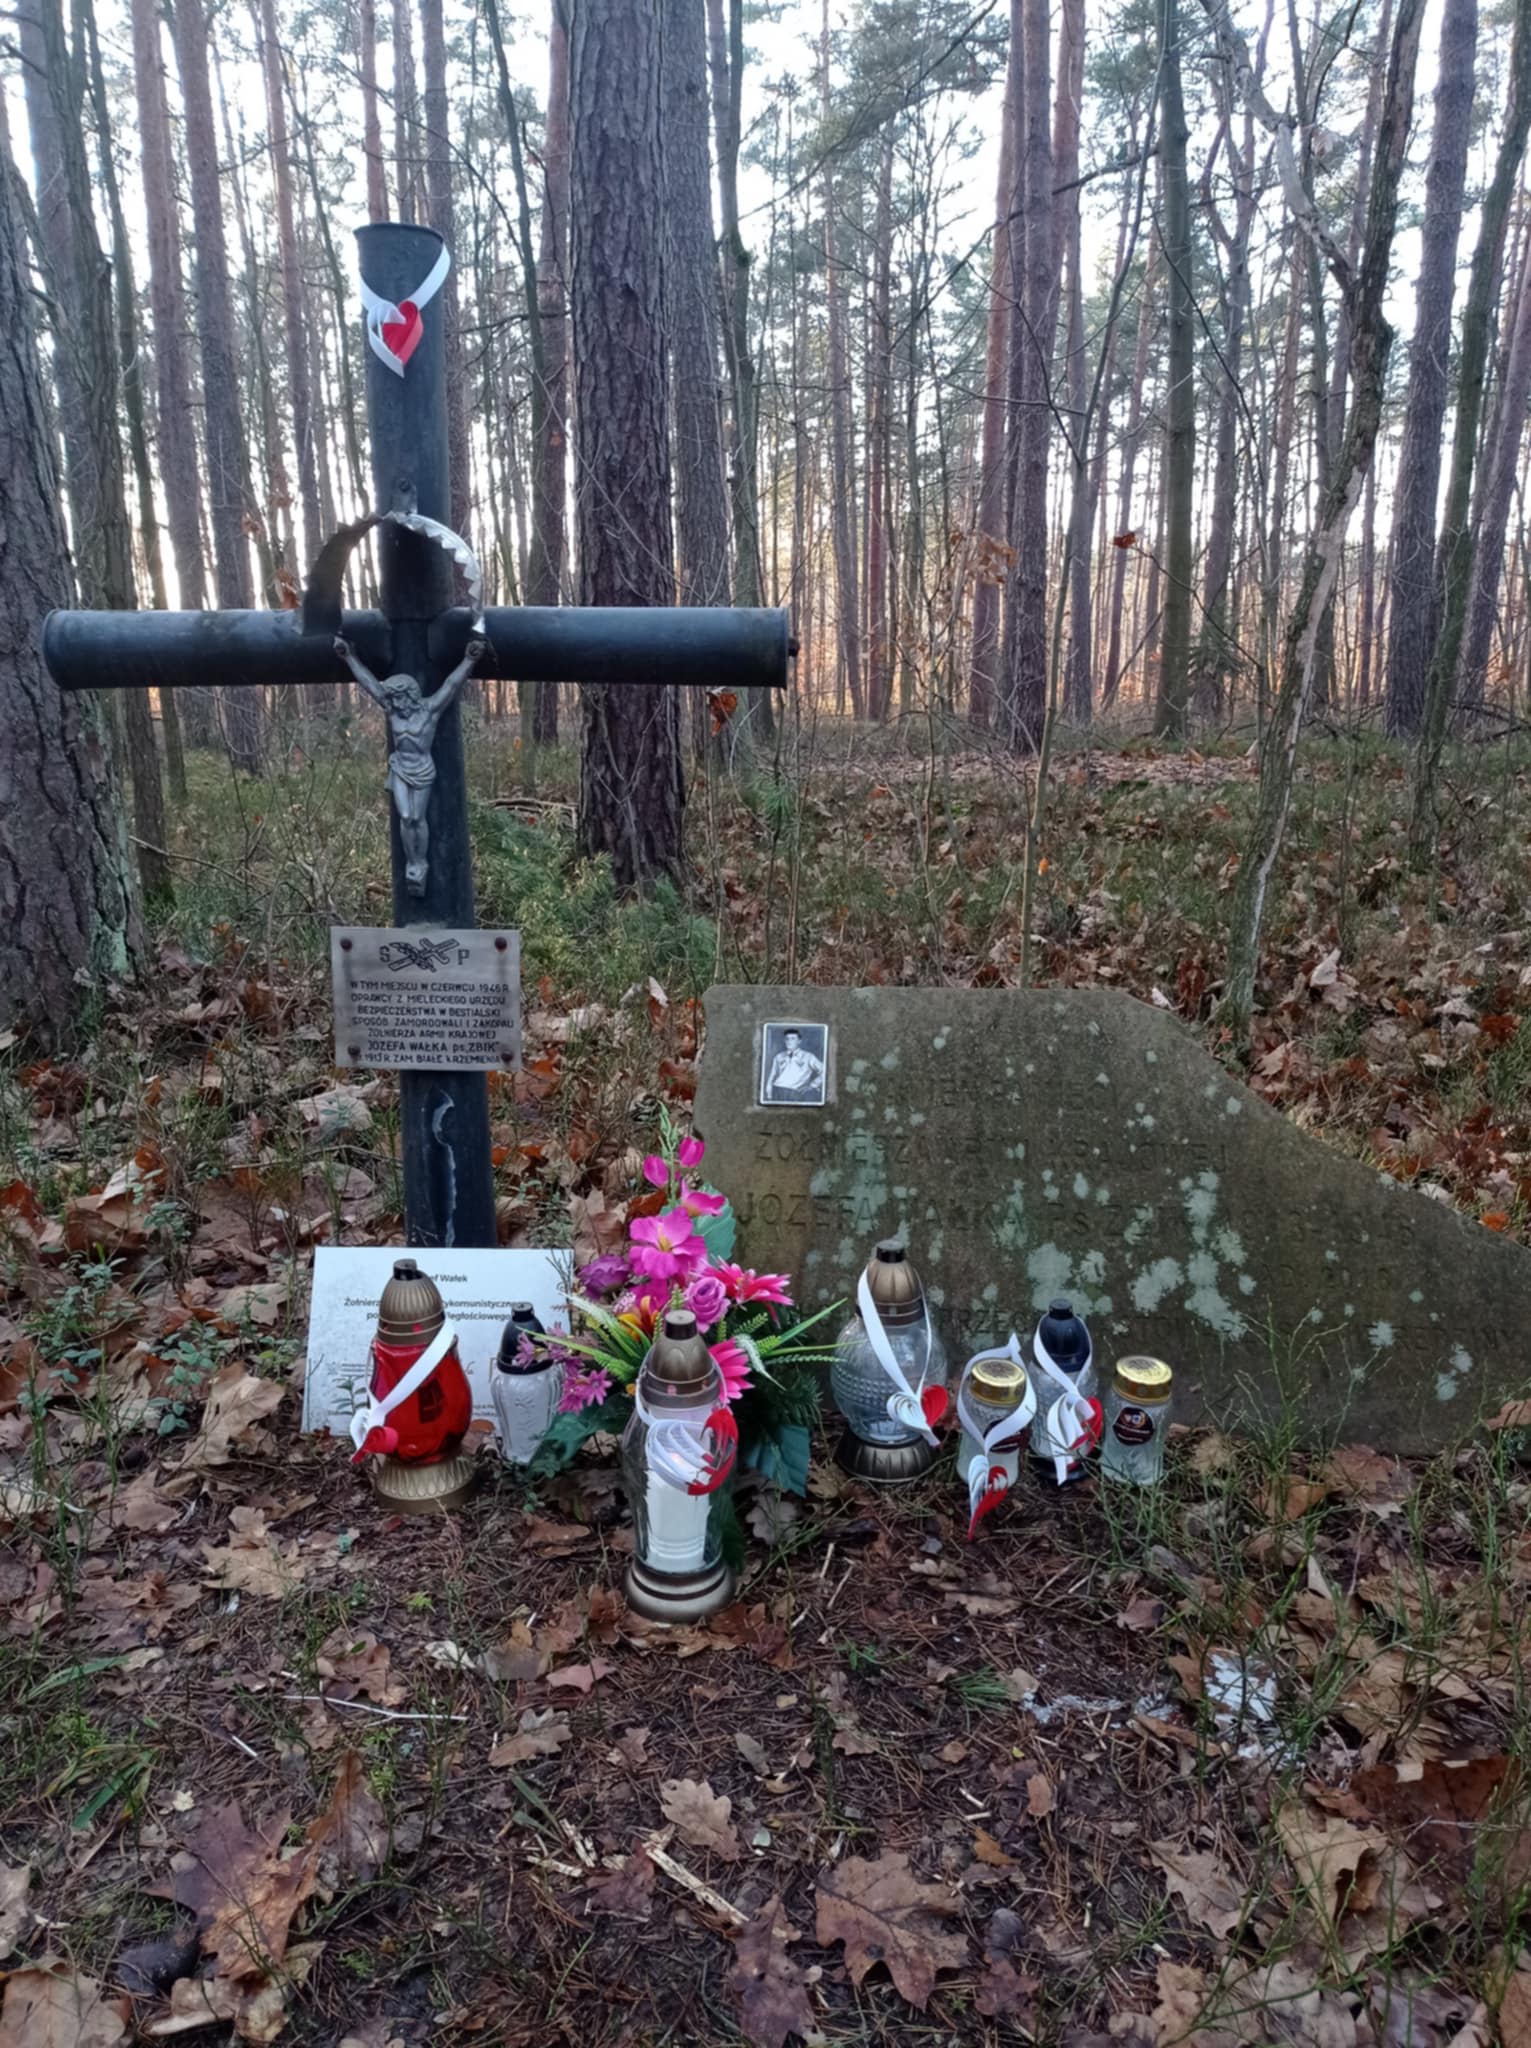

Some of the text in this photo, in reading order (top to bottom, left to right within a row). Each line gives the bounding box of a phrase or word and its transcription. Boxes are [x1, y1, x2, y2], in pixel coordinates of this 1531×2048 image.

[380, 945, 470, 965] S P
[360, 981, 379, 990] TYM
[381, 981, 417, 991] MIEJSCU
[421, 983, 428, 991] W
[431, 983, 475, 992] CZERWCU
[351, 993, 392, 1003] OPRAWCY
[397, 994, 403, 1003] Z
[408, 994, 466, 1004] MIELECKIEGO
[449, 1008, 500, 1017] BESTIALSKI
[395, 1018, 462, 1028] ZAMORDOWALI
[448, 1030, 496, 1040] KRAJOWEJ
